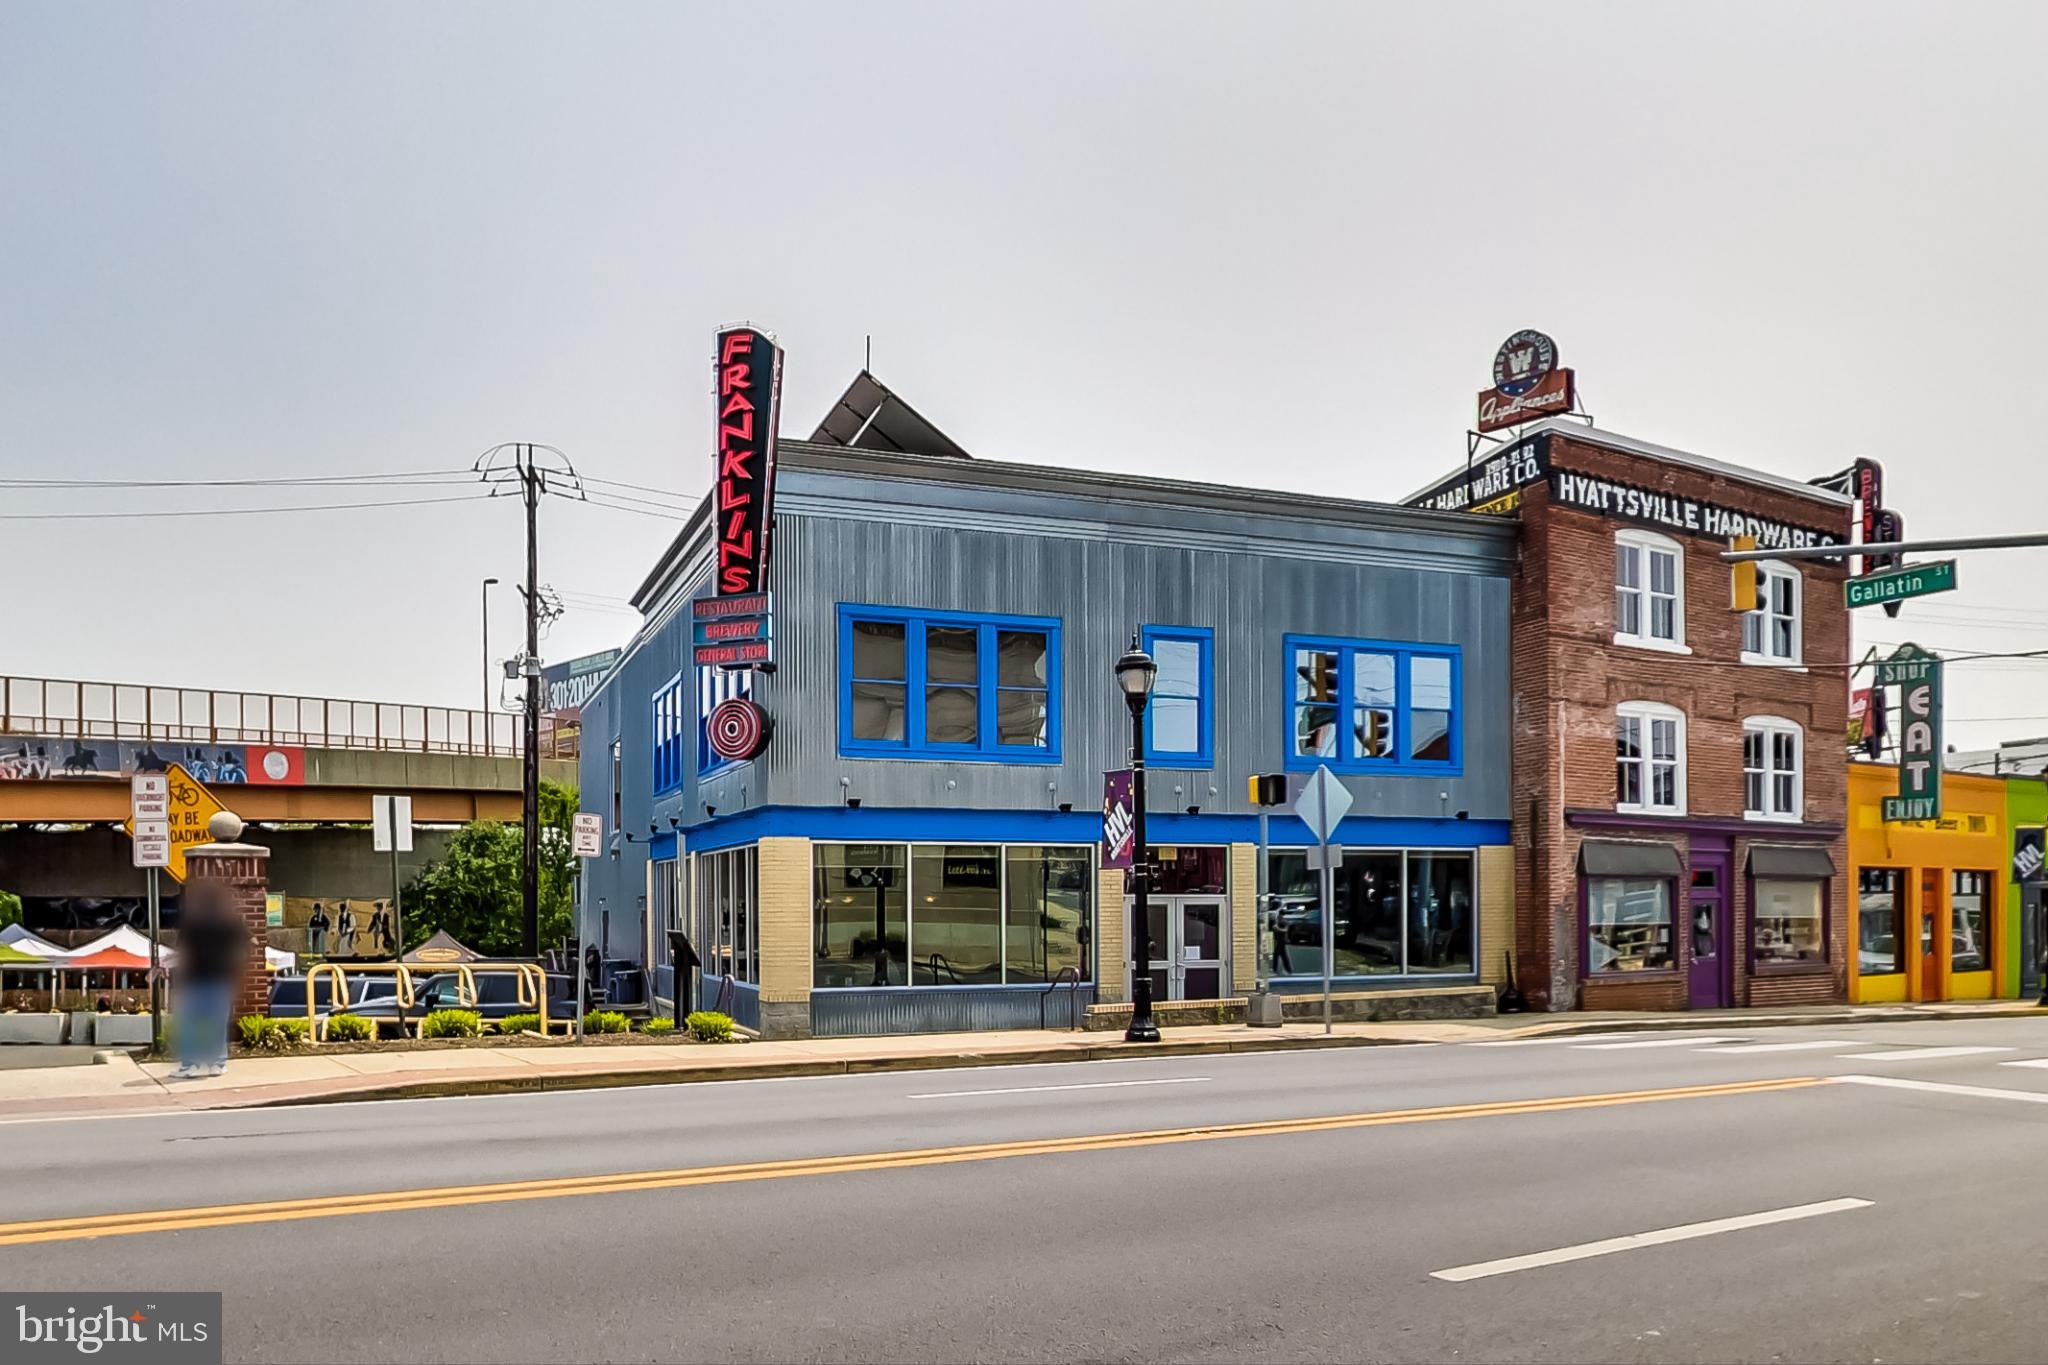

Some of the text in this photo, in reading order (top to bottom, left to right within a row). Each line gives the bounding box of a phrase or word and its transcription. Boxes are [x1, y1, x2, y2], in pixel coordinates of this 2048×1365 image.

[1480, 388, 1565, 423] Appliances
[720, 334, 755, 594] FRANKLINS
[1514, 458, 1540, 484] CO.
[1559, 473, 1700, 530] HYATTSVILLE
[1850, 564, 1949, 603] Gallatin ST
[705, 622, 759, 639] BREWERY
[696, 647, 737, 663] GENERAL
[1906, 685, 1931, 791] EAT
[184, 811, 199, 825] BE
[582, 817, 593, 825] NO
[1886, 798, 1935, 820] ENJOY
[575, 825, 599, 835] PARKING
[1103, 801, 1133, 848] HVL
[2013, 843, 2045, 874] HVL
